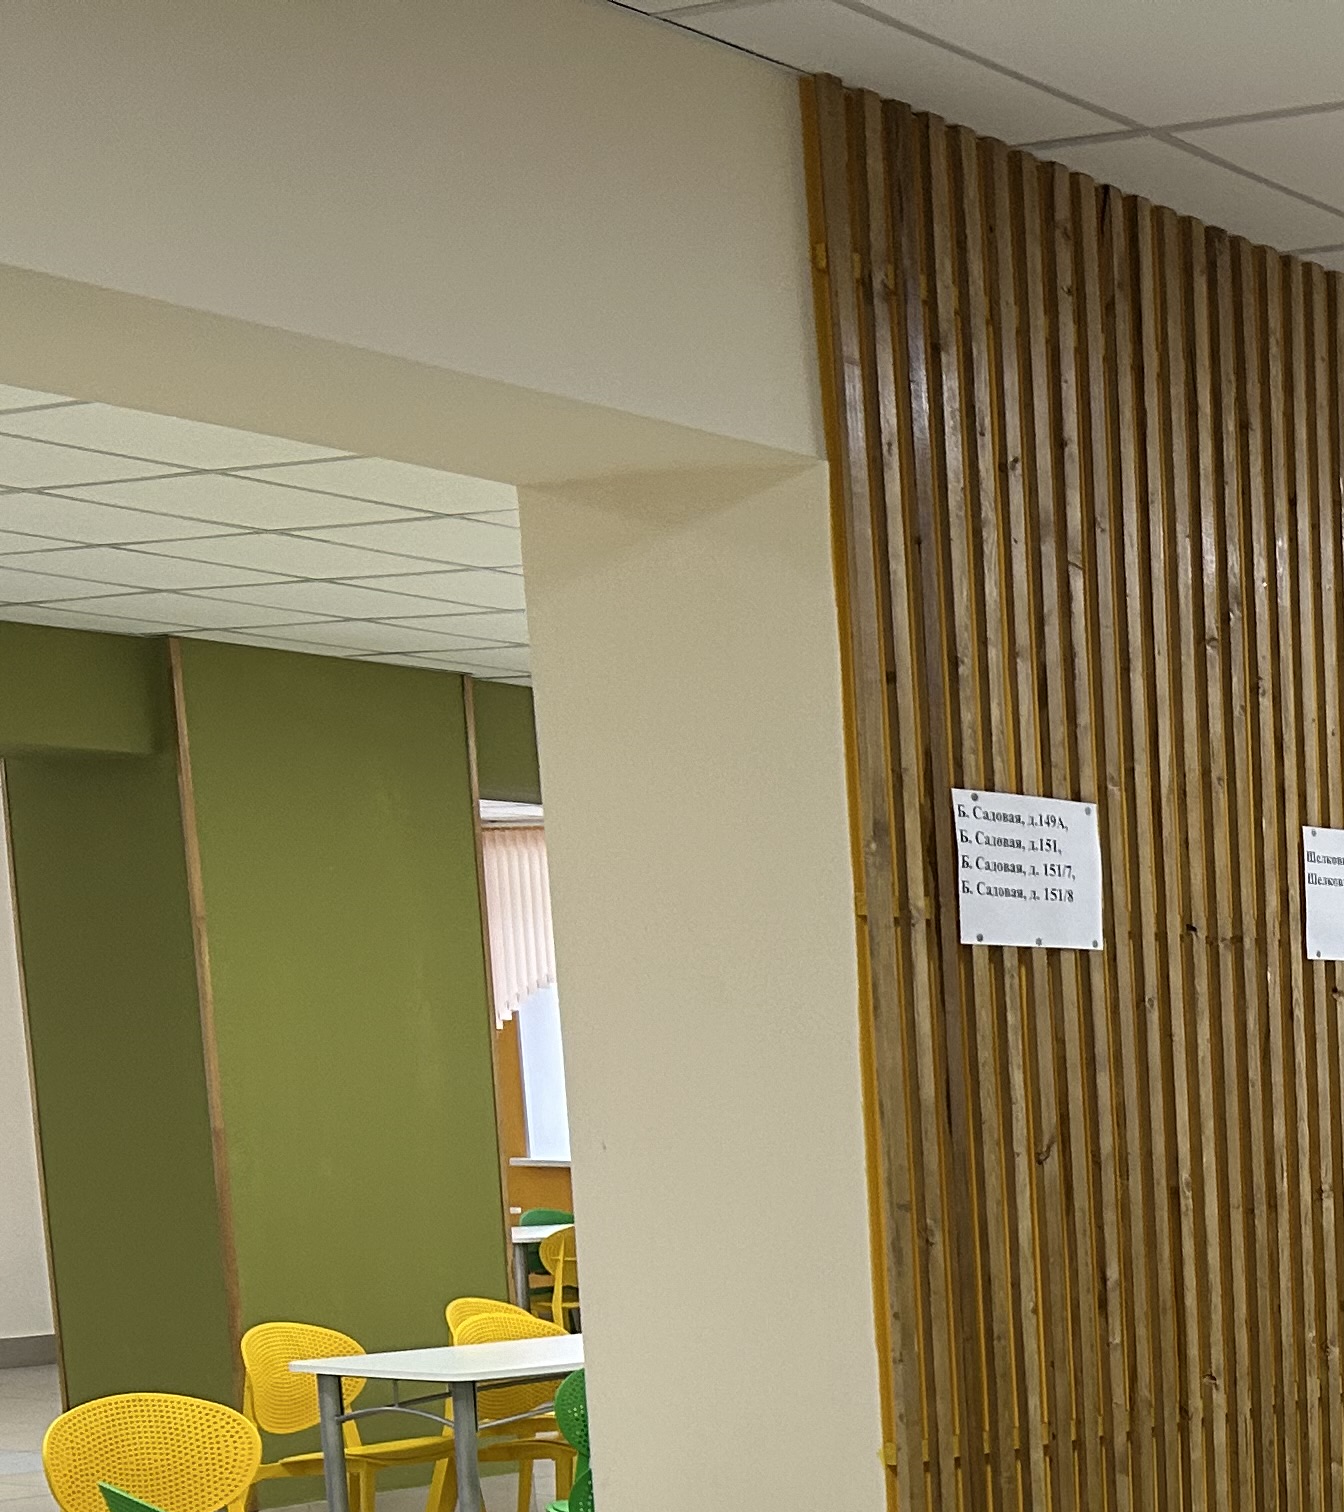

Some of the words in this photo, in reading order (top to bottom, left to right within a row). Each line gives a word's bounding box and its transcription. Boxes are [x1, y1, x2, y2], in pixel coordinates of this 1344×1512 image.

[957, 803, 969, 818] Б.
[972, 805, 1025, 826] Садовая,
[959, 829, 972, 844] Б.
[975, 830, 1026, 851] Садовая,
[1028, 838, 1063, 856] д.151,
[961, 854, 973, 870] Б.
[975, 856, 1027, 876] Садовая,
[1043, 863, 1076, 882] 151/7,
[961, 880, 973, 895] Б.
[976, 881, 1027, 901] Садовая,
[1044, 887, 1074, 903] 151/8
